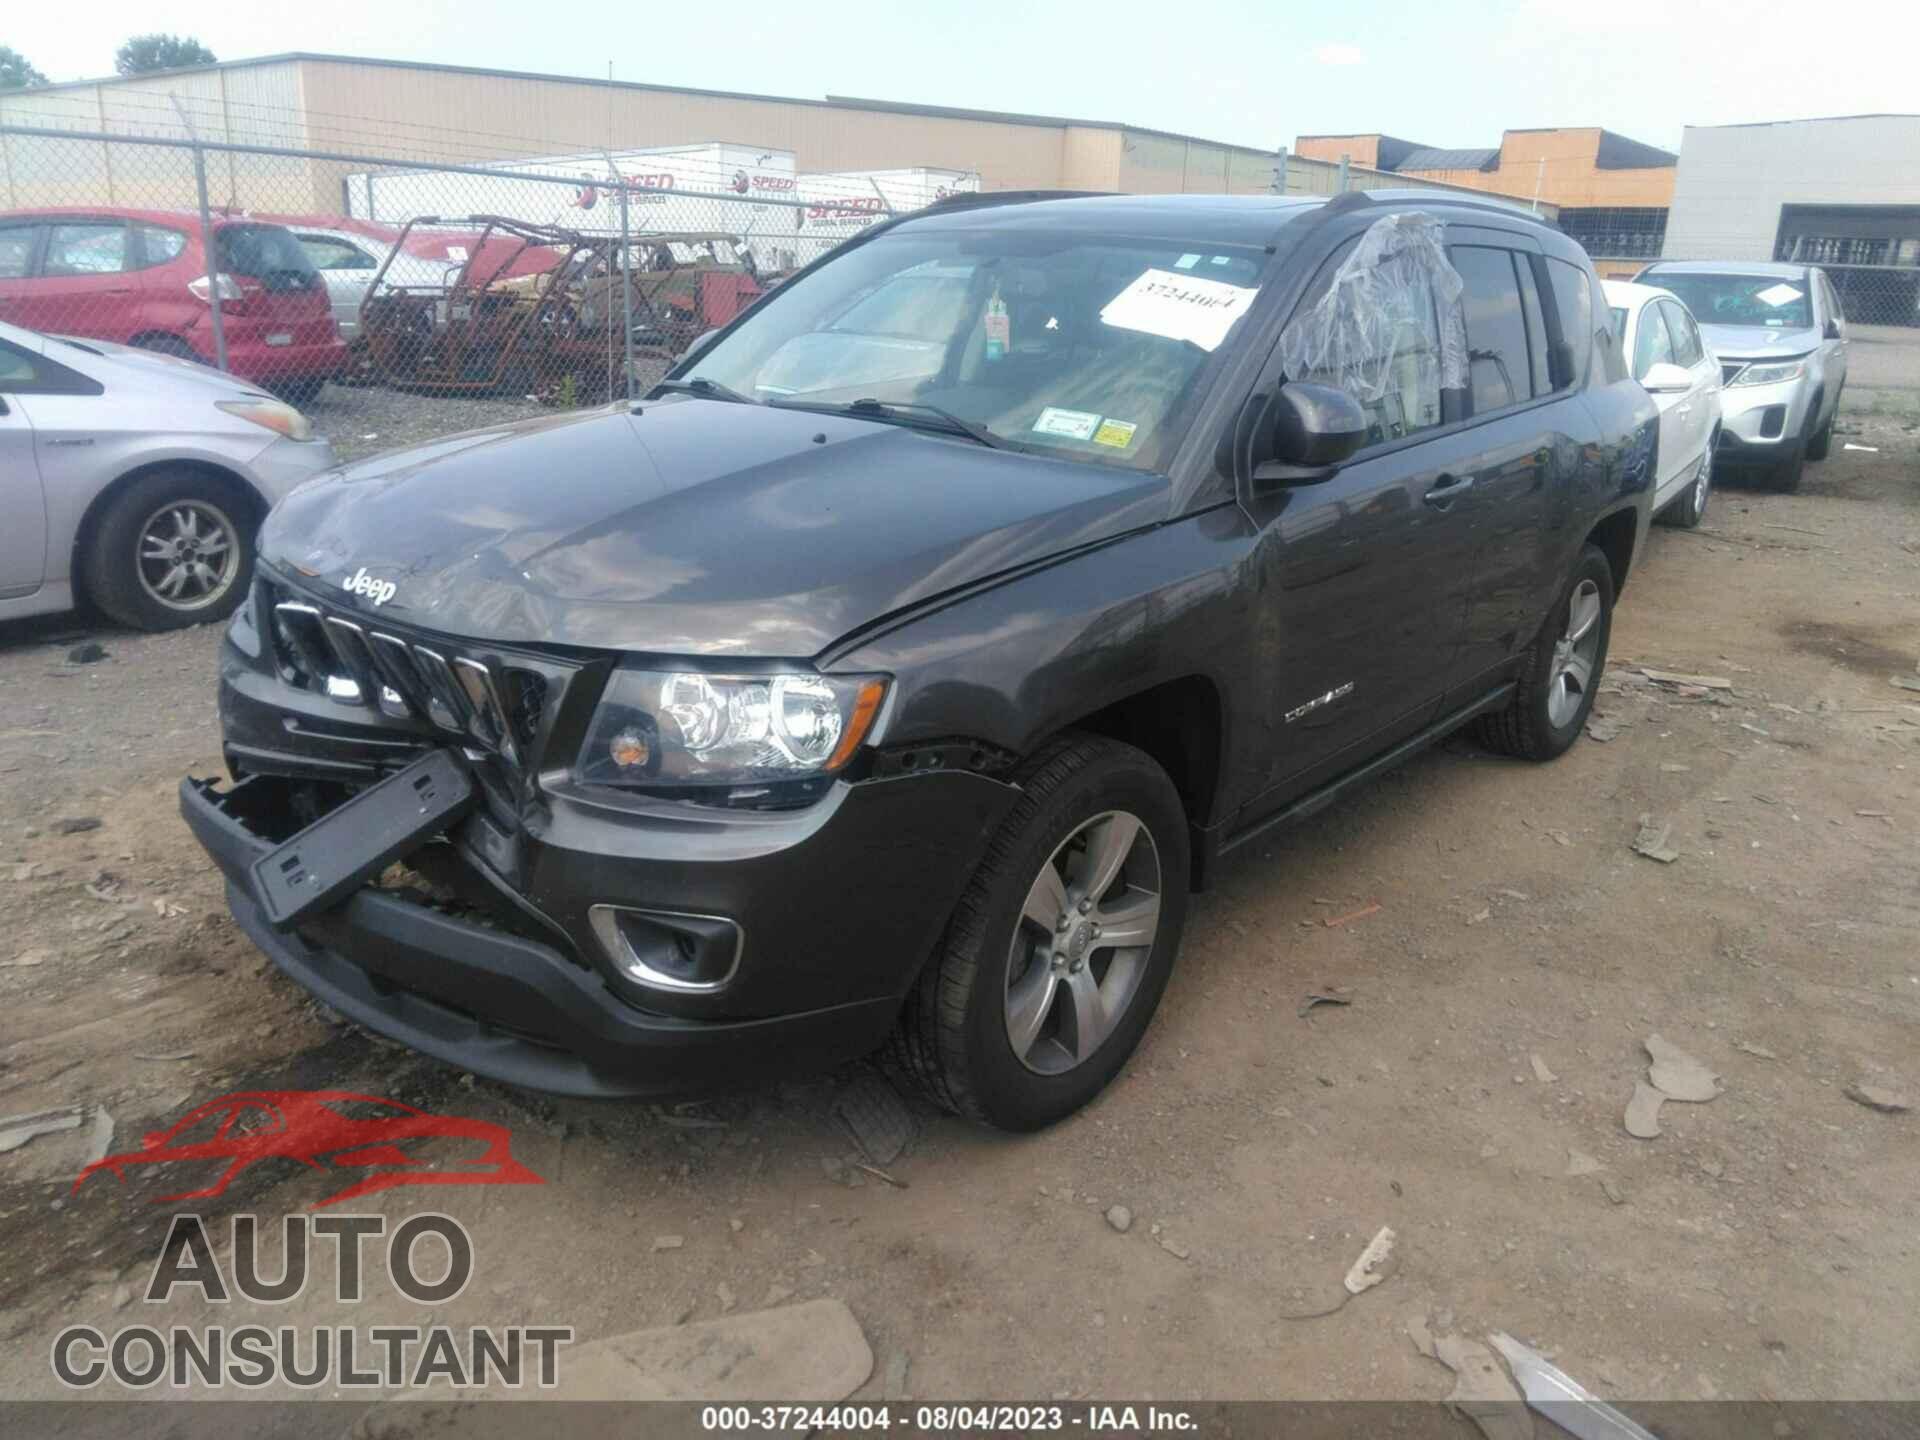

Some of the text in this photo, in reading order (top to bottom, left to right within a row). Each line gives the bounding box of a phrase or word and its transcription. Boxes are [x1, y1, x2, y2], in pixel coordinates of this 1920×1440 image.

[751, 175, 794, 189] SPEED
[807, 198, 884, 219] SPEED
[343, 567, 397, 606] Jeep
